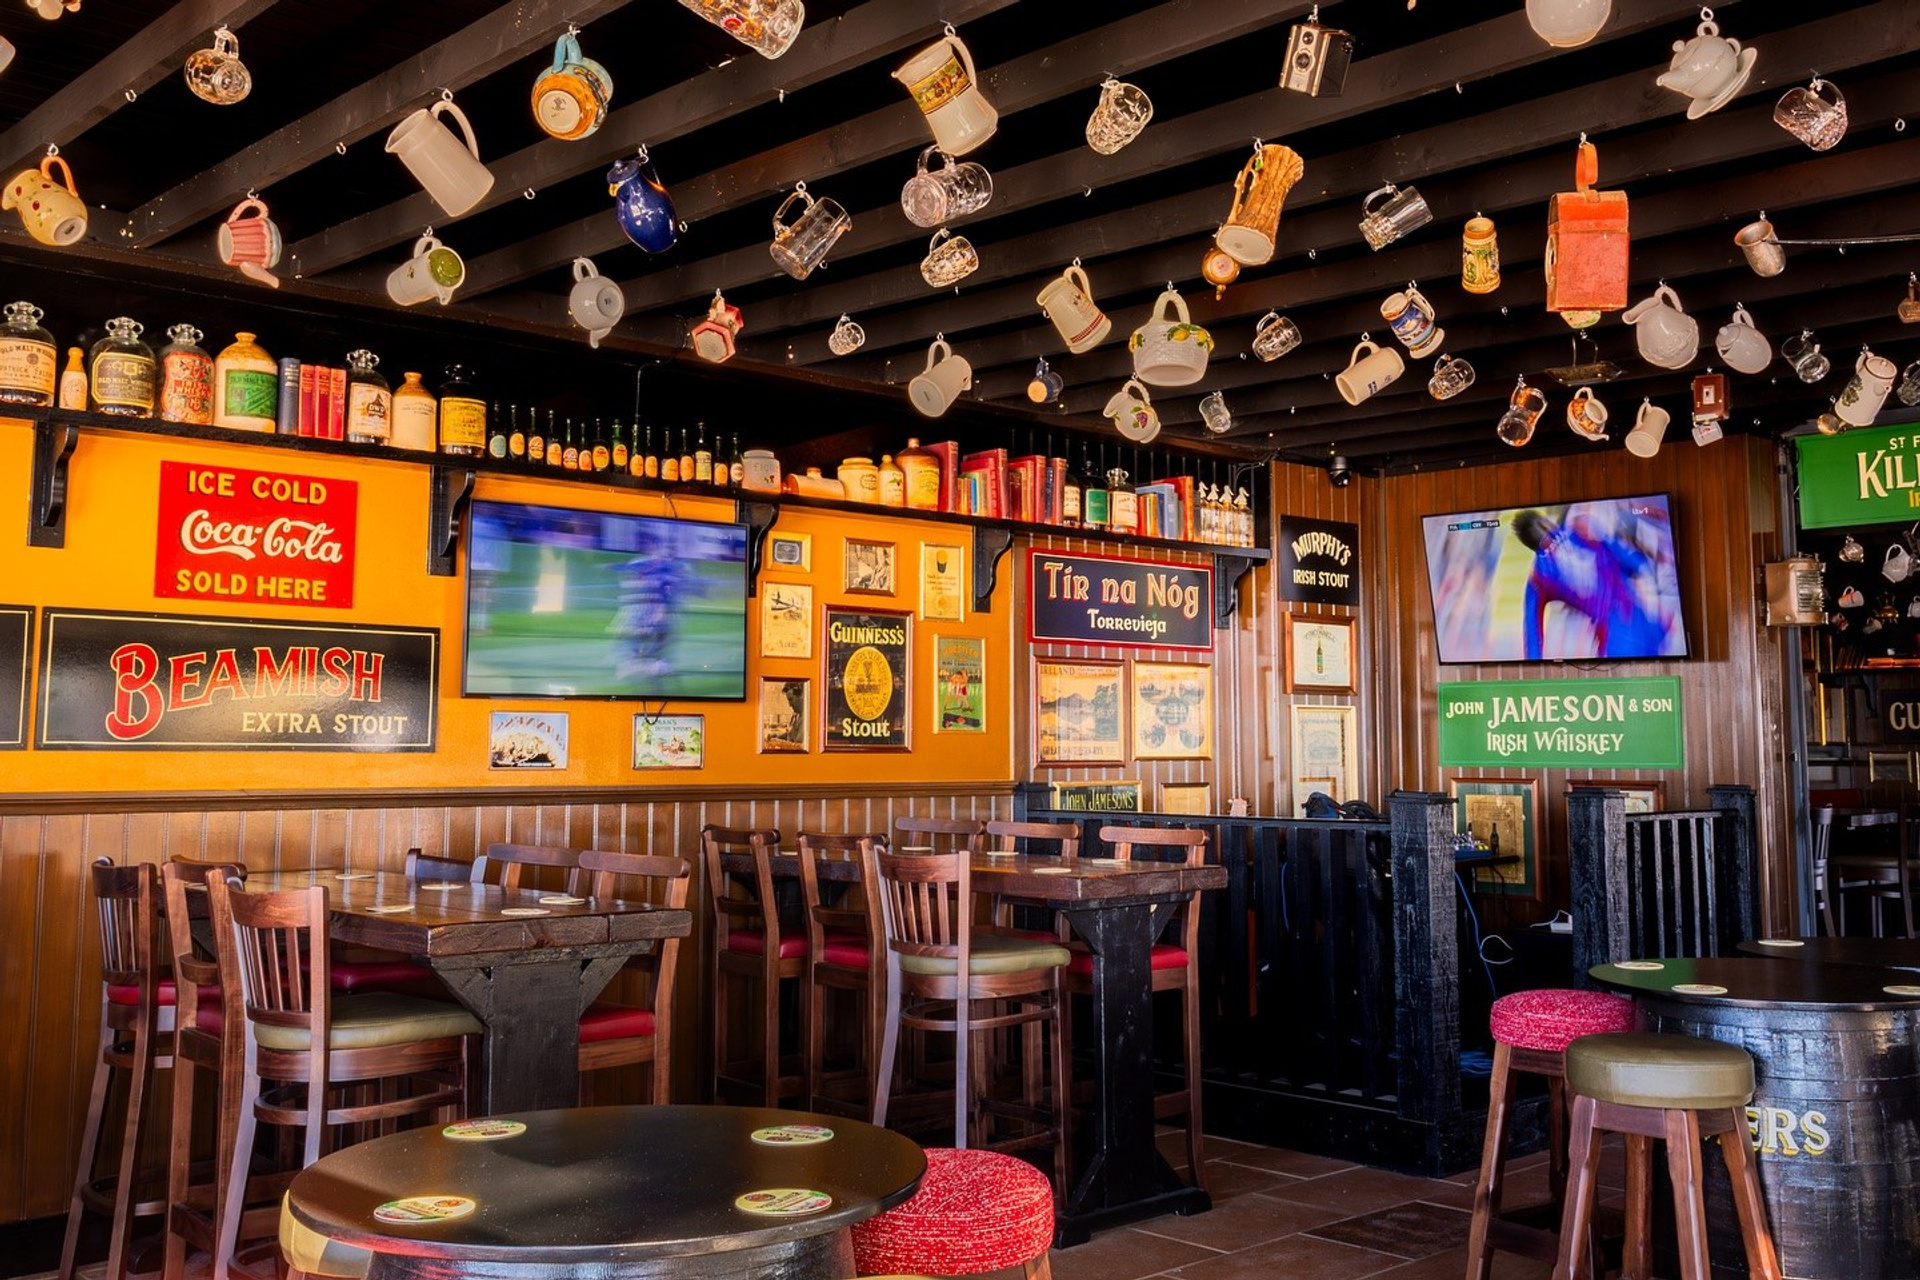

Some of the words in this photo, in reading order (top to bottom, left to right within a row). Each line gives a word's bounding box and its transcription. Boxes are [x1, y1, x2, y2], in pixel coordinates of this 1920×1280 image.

[188, 470, 236, 497] ICE
[252, 476, 327, 505] COLD
[181, 509, 343, 564] Coca-Cola
[1291, 531, 1352, 567] MURPHY'S
[176, 569, 248, 595] SOLD
[255, 576, 327, 601] HERE
[1043, 562, 1090, 601] Tír
[1101, 577, 1137, 605] na
[1146, 573, 1199, 619] Nóg
[1293, 569, 1316, 586] IRISH
[1318, 571, 1350, 588] STOUT
[830, 621, 905, 646] GUINNESS'S
[1086, 608, 1167, 640] Torrevieja
[105, 642, 385, 740] BEAMISH
[242, 712, 323, 735] EXTRA
[333, 713, 408, 736] STOUT
[842, 717, 891, 738] Stout
[1446, 701, 1484, 718] JOHN
[1487, 694, 1626, 729] JAMESON
[1628, 699, 1638, 712] &
[1642, 698, 1673, 712] SON
[1487, 731, 1528, 756] IRISH
[1533, 727, 1624, 755] WHISKEY
[1062, 790, 1087, 810] JOHN
